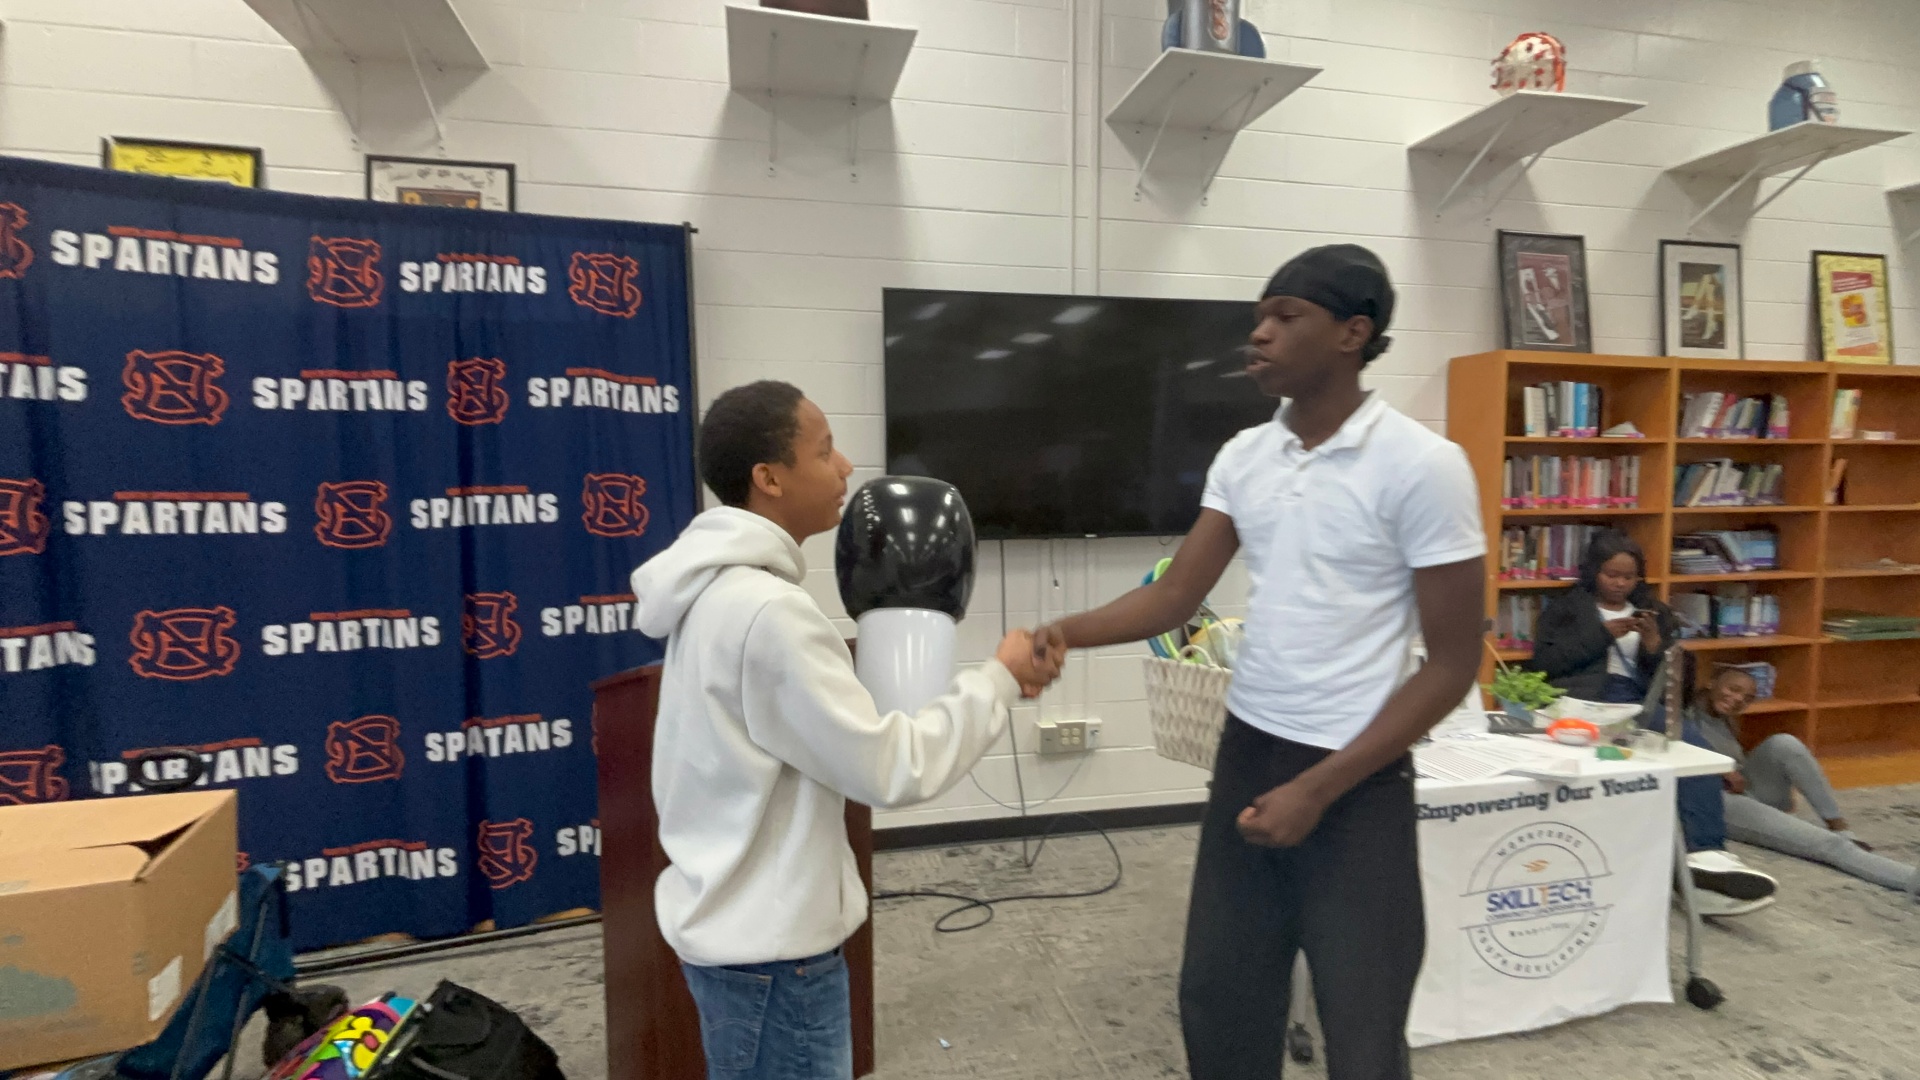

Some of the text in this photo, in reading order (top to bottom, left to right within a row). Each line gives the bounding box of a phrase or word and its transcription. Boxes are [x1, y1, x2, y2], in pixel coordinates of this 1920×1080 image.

[50, 229, 280, 286] SPARTANS
[399, 261, 548, 295] SPARTANS
[252, 377, 428, 412] SPARTANS
[528, 377, 680, 414] SPARTANS
[62, 501, 288, 536] SPARTANS
[1416, 773, 1659, 821] Empowering Our Youth
[1486, 881, 1593, 912] SKILLTECH
